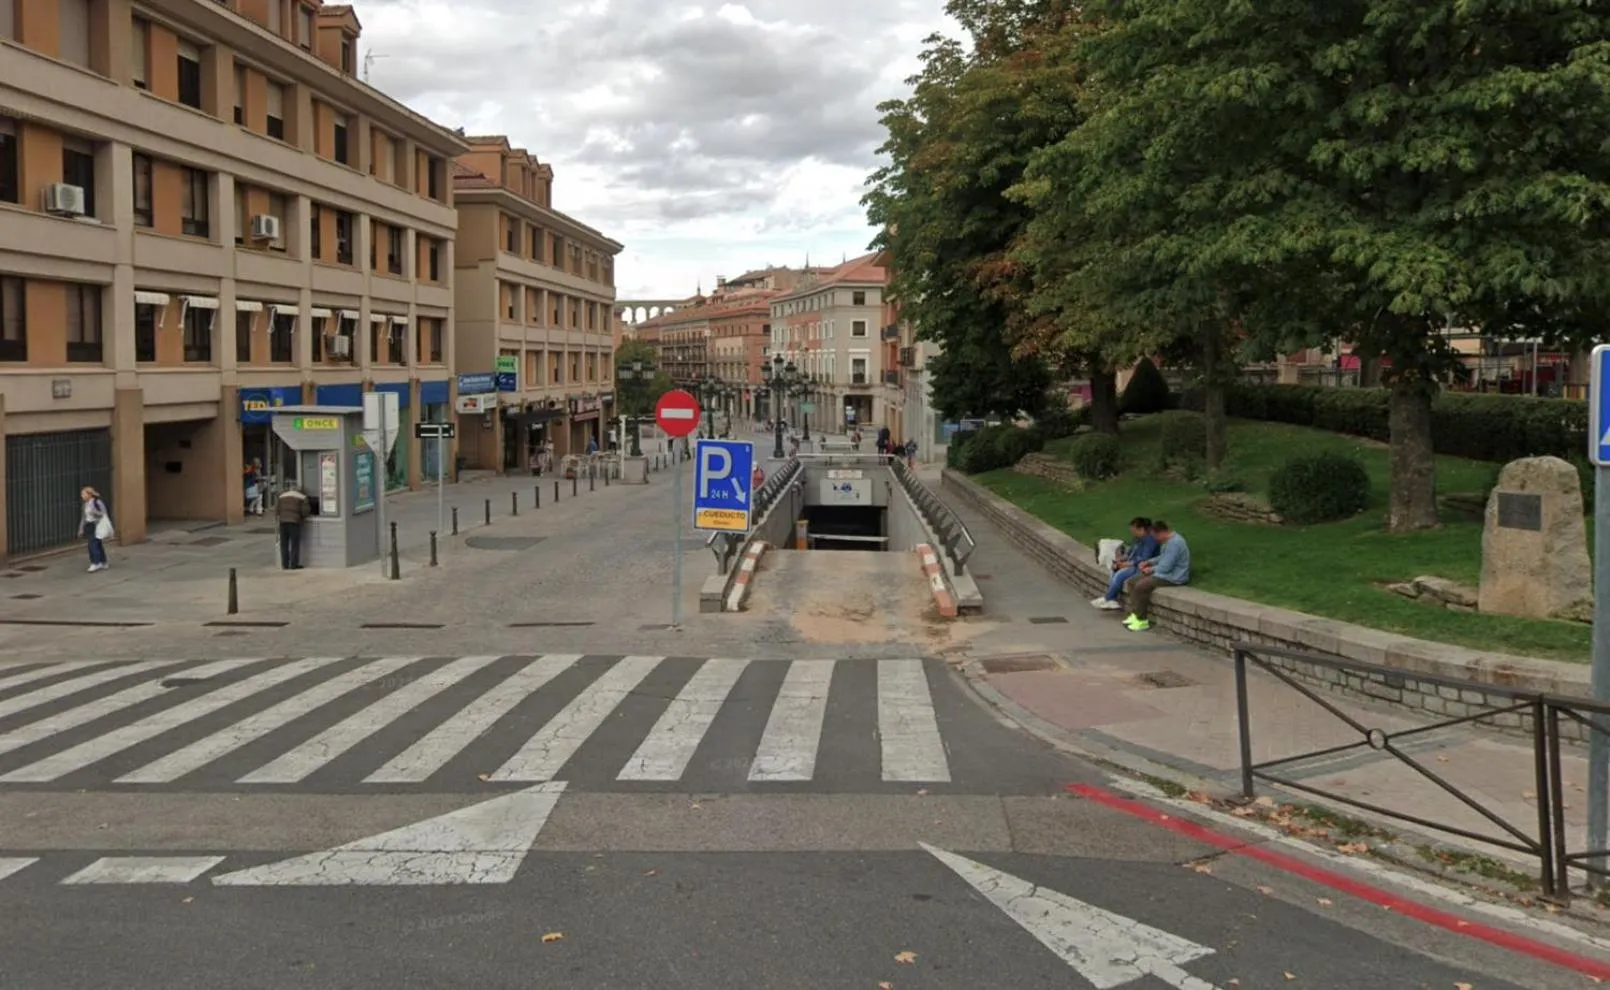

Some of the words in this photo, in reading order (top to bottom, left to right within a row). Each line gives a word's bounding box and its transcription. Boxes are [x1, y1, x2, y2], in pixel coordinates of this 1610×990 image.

[307, 420, 334, 428] ONCE
[700, 445, 732, 498] P
[699, 510, 746, 520] CUEDUCTO
